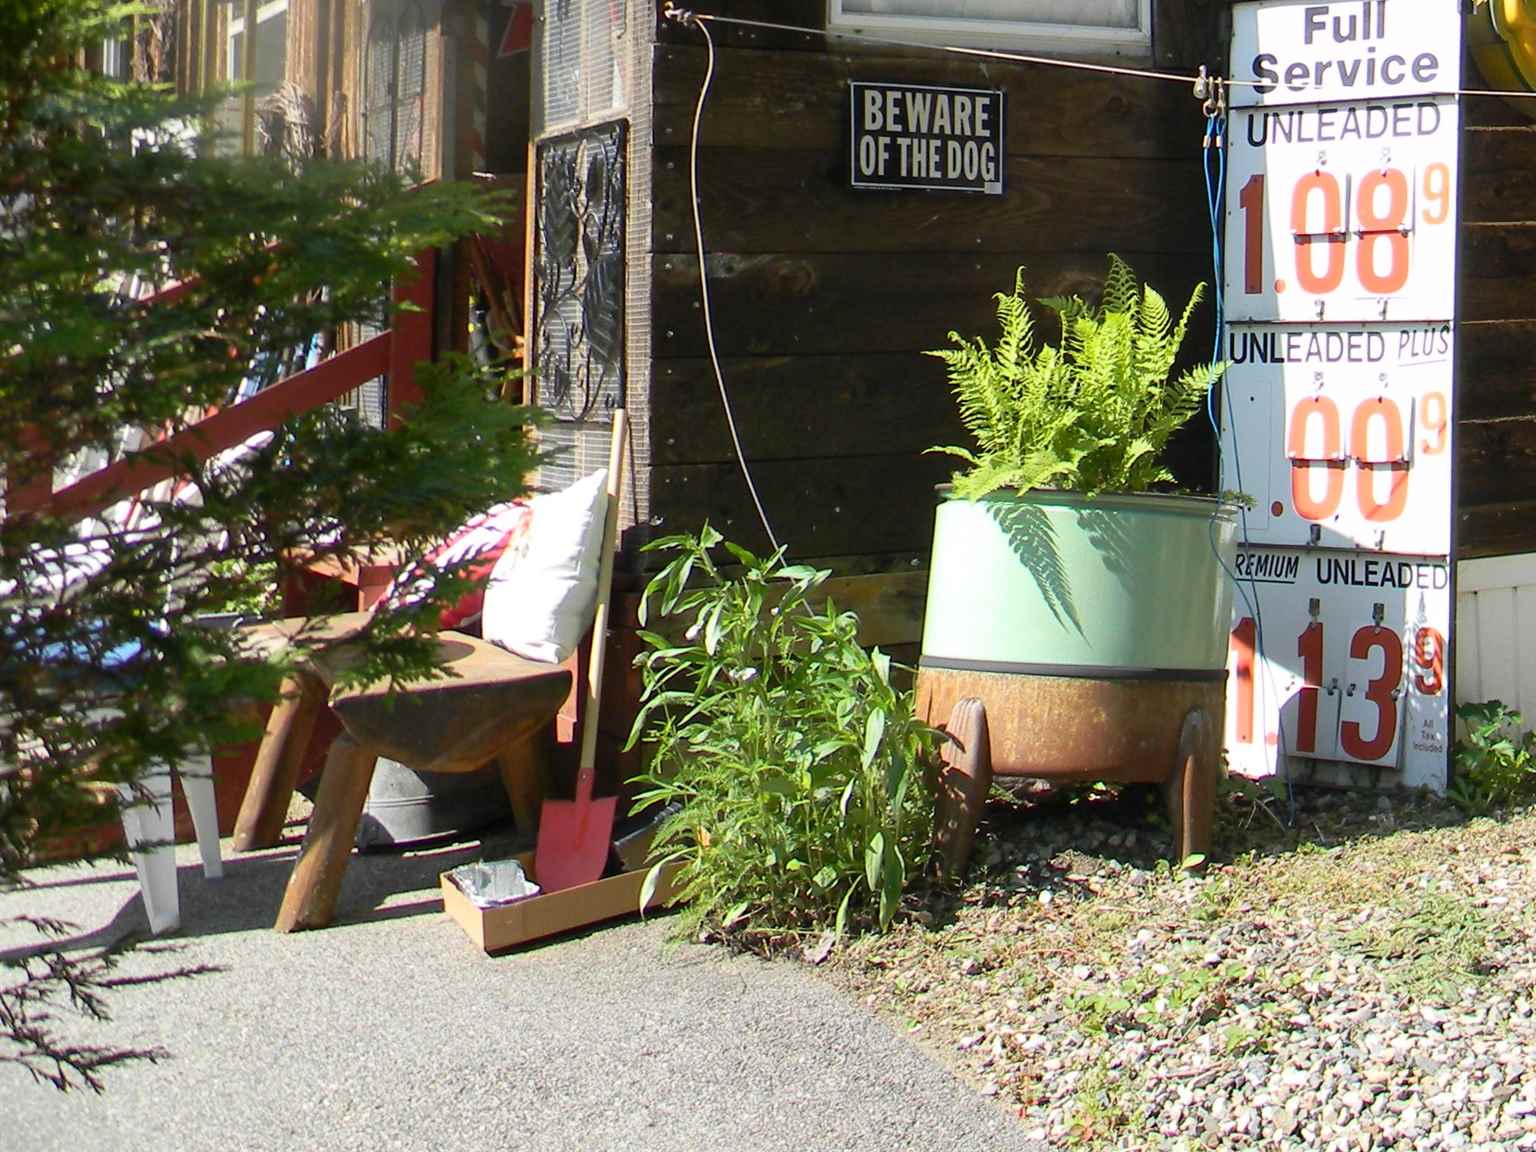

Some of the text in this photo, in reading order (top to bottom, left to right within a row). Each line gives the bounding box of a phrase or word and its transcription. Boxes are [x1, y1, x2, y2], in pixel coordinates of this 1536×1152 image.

[1303, 0, 1387, 45] Full
[1252, 47, 1440, 94] Service
[864, 89, 991, 137] BEWARE
[1247, 102, 1441, 148] UNLEADED
[859, 134, 996, 182] OF THE DOG
[1228, 324, 1450, 365] UNLEADED PLUS
[1234, 553, 1449, 591] REMIUM UNLEADED
